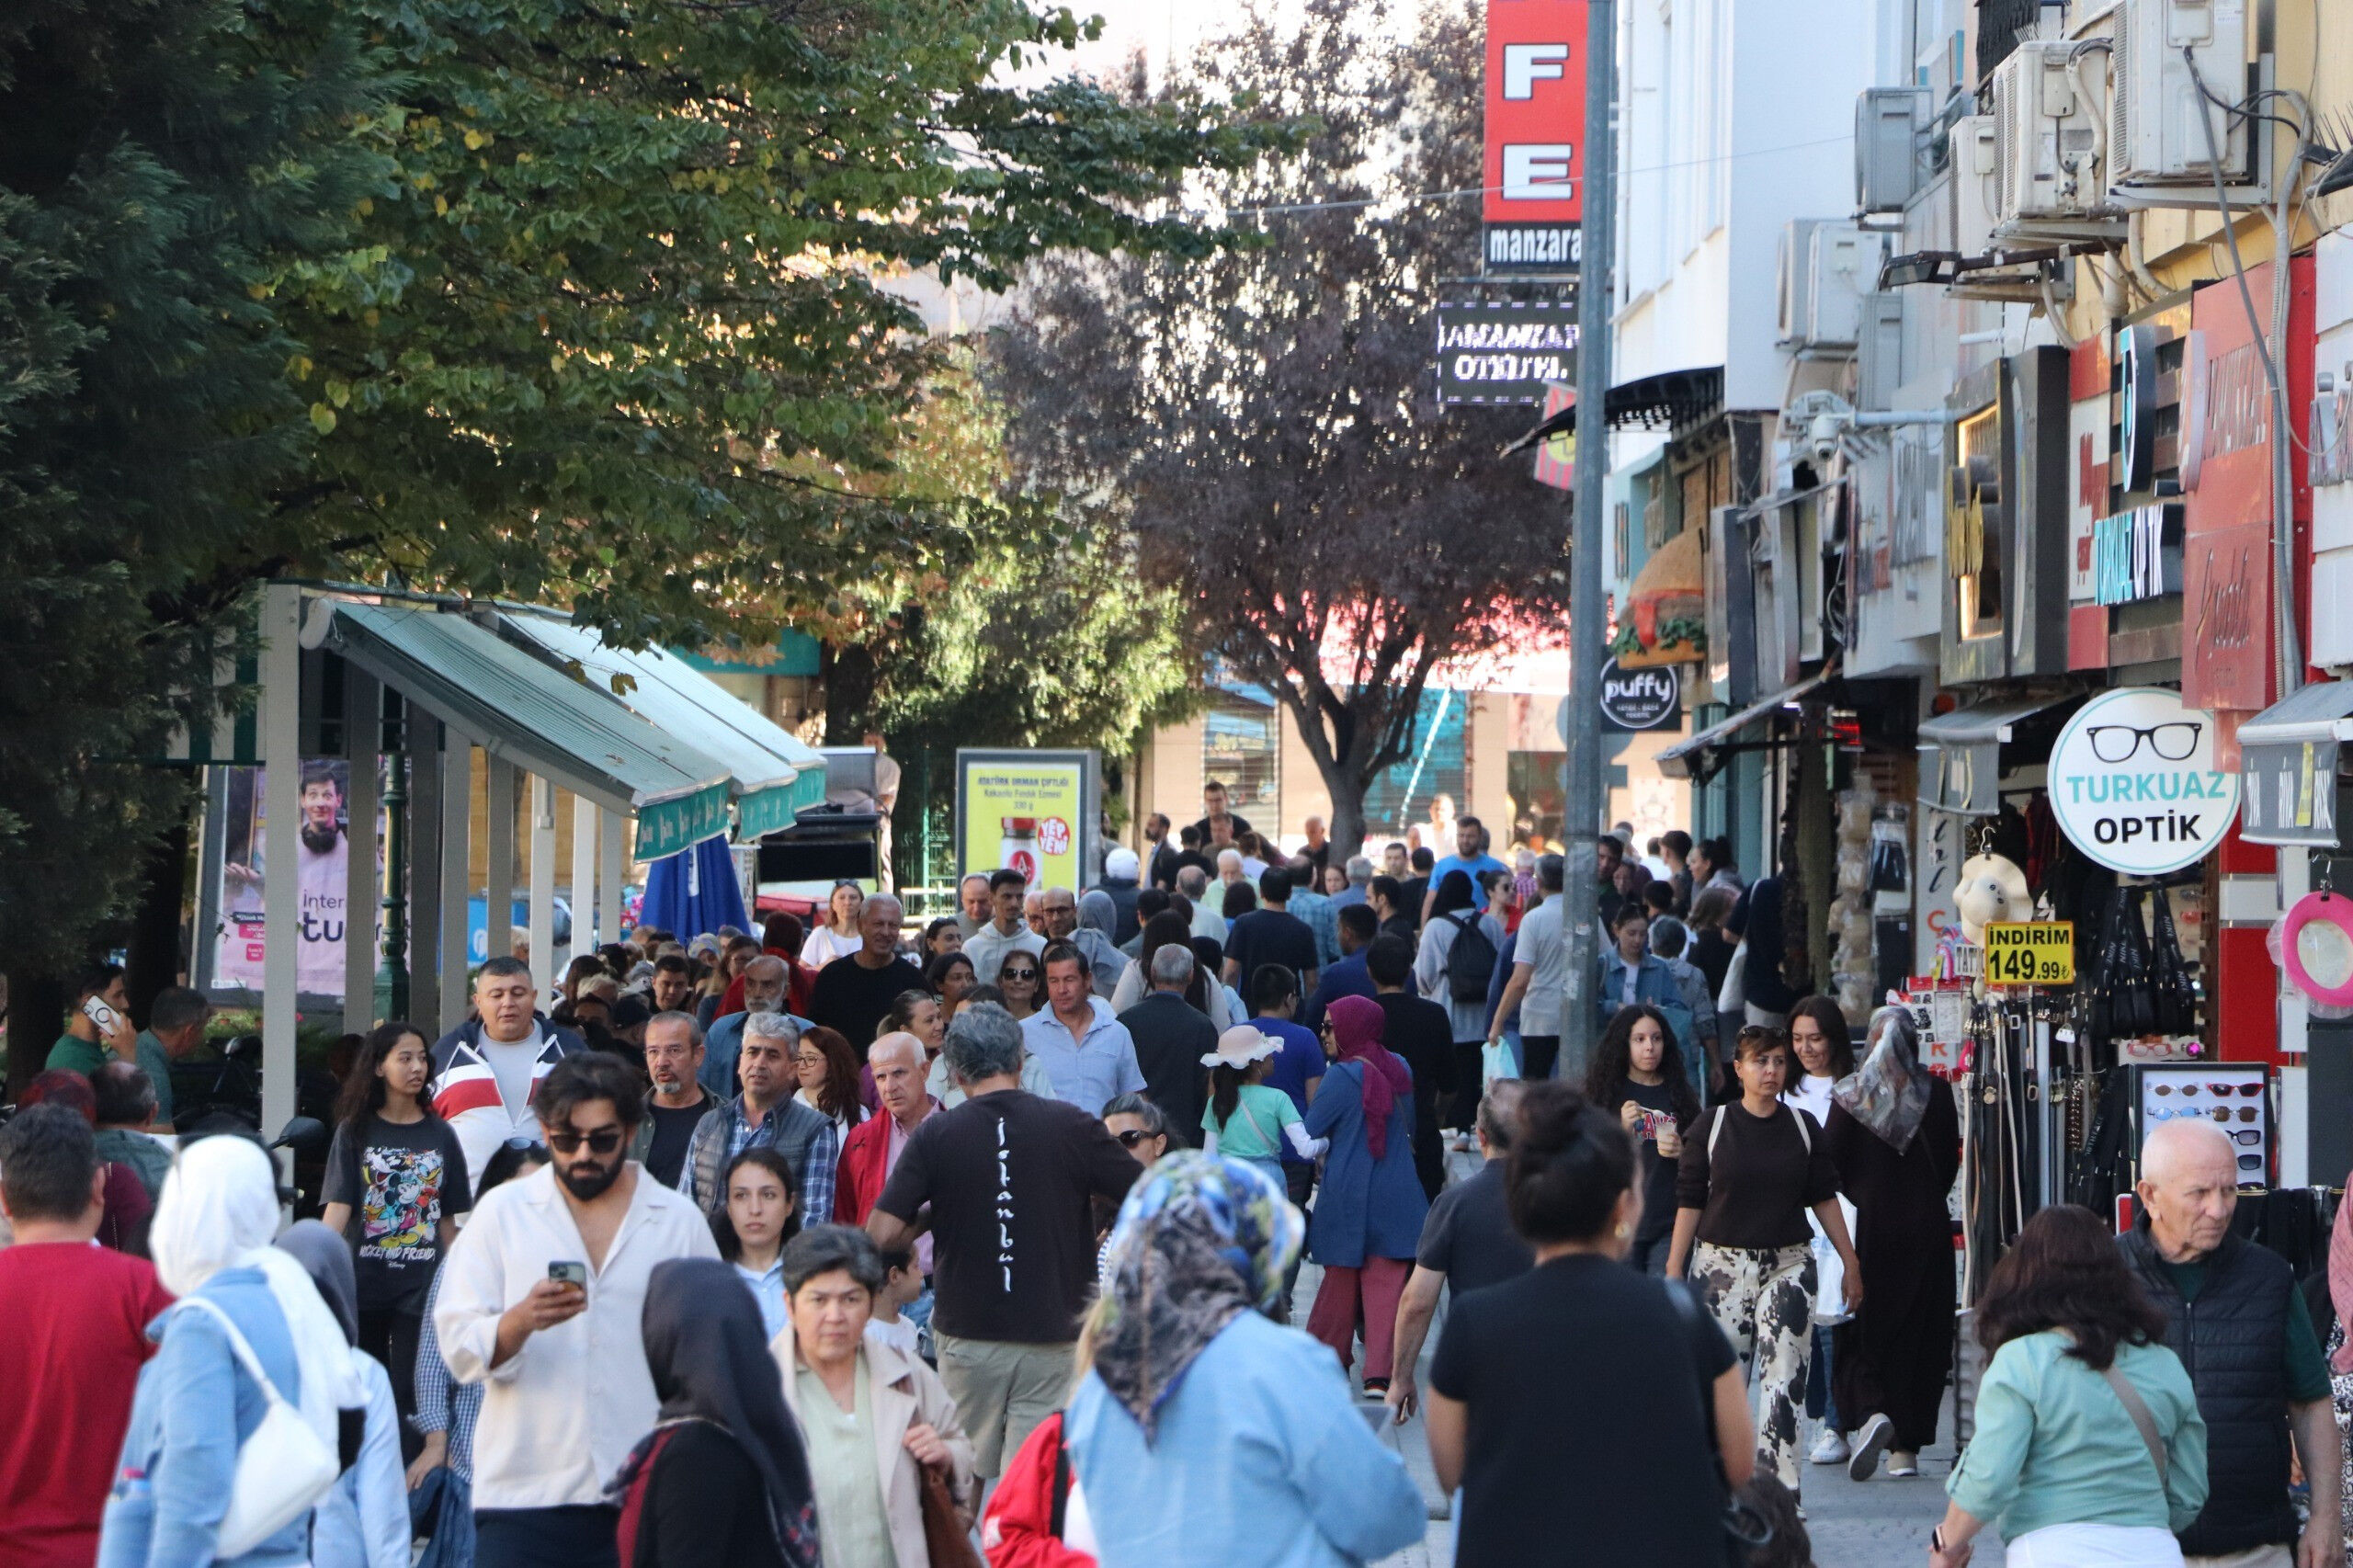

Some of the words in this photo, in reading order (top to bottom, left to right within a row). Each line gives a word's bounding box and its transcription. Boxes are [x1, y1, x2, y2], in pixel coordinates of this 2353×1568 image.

[1490, 229, 1581, 263] manzara
[1605, 672, 1671, 704] puffy
[2066, 771, 2227, 804] TURKUAZ
[2094, 810, 2201, 844] OPTİK
[1990, 926, 2069, 945] İNDİRİM
[996, 1117, 1015, 1291] istanbul
[359, 1244, 384, 1259] MICKEY
[385, 1246, 403, 1260] AND
